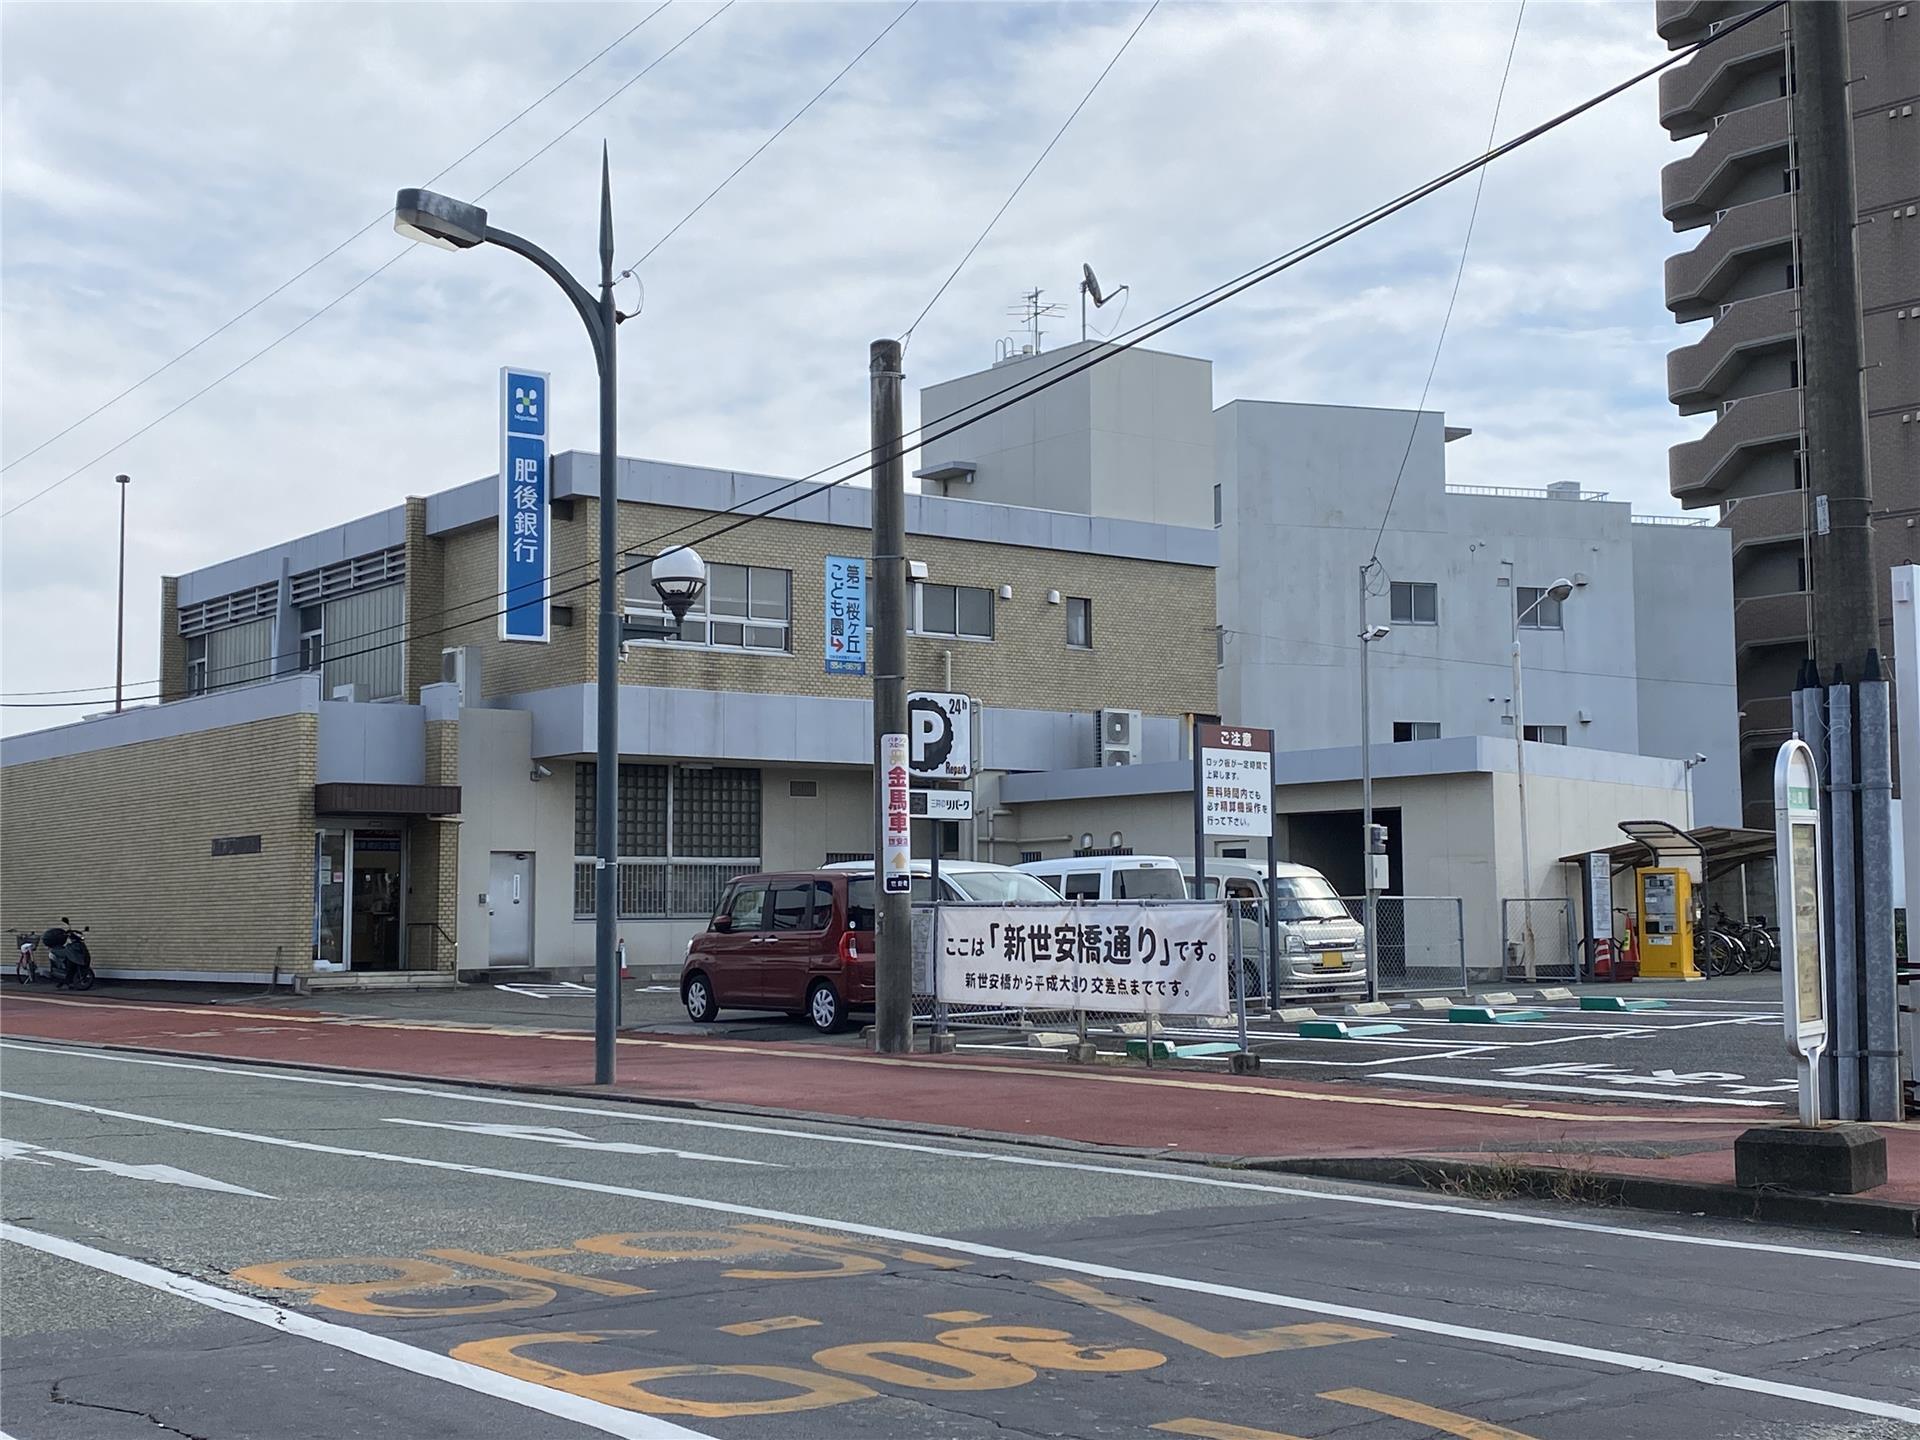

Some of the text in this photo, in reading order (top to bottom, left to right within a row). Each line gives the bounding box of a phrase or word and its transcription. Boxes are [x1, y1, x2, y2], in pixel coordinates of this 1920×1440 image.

[513, 458, 539, 563] 肥後銀行
[830, 564, 844, 636] こども園
[911, 709, 945, 762] P
[1220, 731, 1252, 747] ご注意
[945, 761, 967, 776] Repark
[888, 766, 907, 834] 金馬車
[1207, 786, 1261, 800] 無料時間内でも
[946, 922, 1217, 967] ここは「新世安橋通り」です。
[965, 973, 1190, 998] 新世安橋から平成大通り交差点までです。
